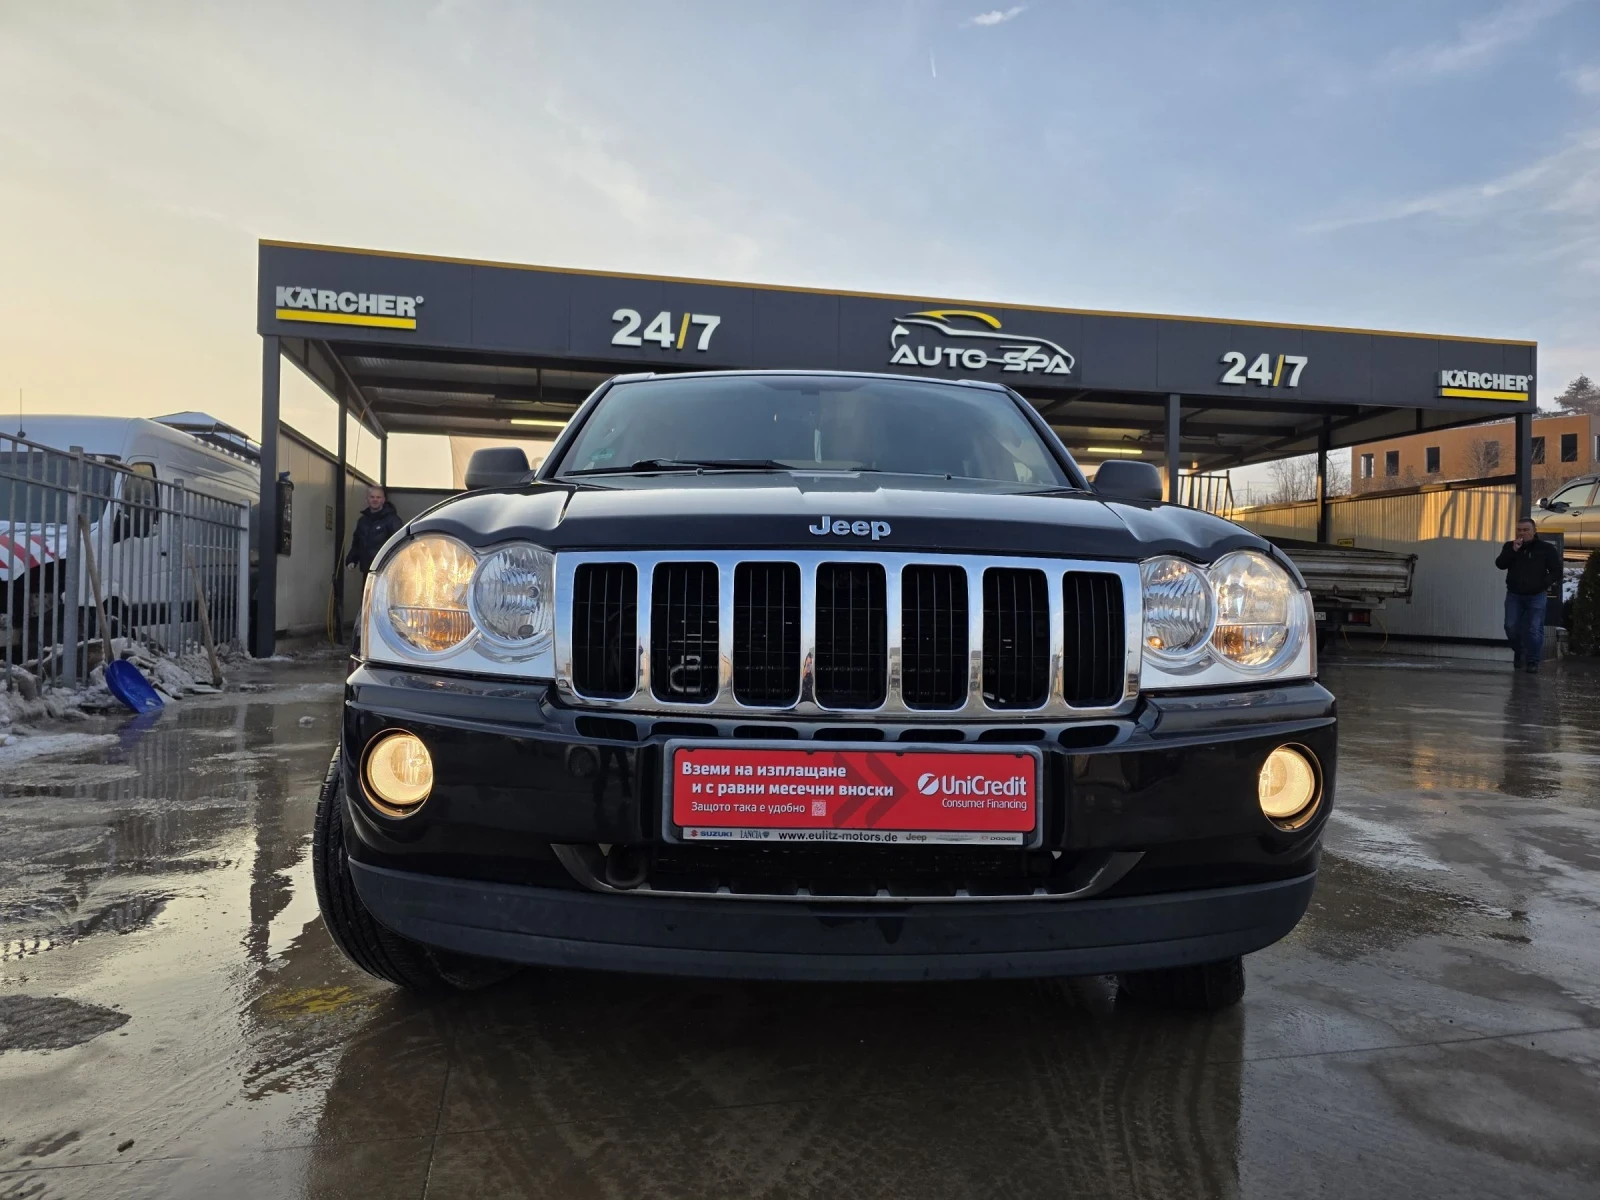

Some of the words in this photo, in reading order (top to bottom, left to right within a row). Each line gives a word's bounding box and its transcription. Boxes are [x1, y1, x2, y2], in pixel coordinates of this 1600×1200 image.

[276, 286, 417, 317] KÄRCHER
[611, 308, 721, 351] 24/7
[1221, 351, 1308, 388] 24/7
[1441, 369, 1529, 391] KÄRCHER
[809, 515, 892, 541] Jeep
[682, 761, 731, 775] Вземи
[734, 765, 754, 776] на
[757, 766, 847, 779] изплащане
[692, 784, 702, 794] и
[705, 784, 714, 794] с
[717, 783, 765, 796] равни
[768, 785, 835, 796] месечни
[838, 785, 895, 797] вноски
[942, 775, 1027, 796] UniCredit
[691, 801, 731, 813] Защото
[733, 803, 757, 812] така
[759, 804, 766, 813] е
[768, 804, 806, 814] удобно
[941, 798, 985, 809] Consumer
[987, 799, 1027, 812] Financing
[700, 830, 732, 838] SUZUKI
[778, 830, 898, 842] www.eulitz-motors.de
[905, 832, 928, 843] Jeep
